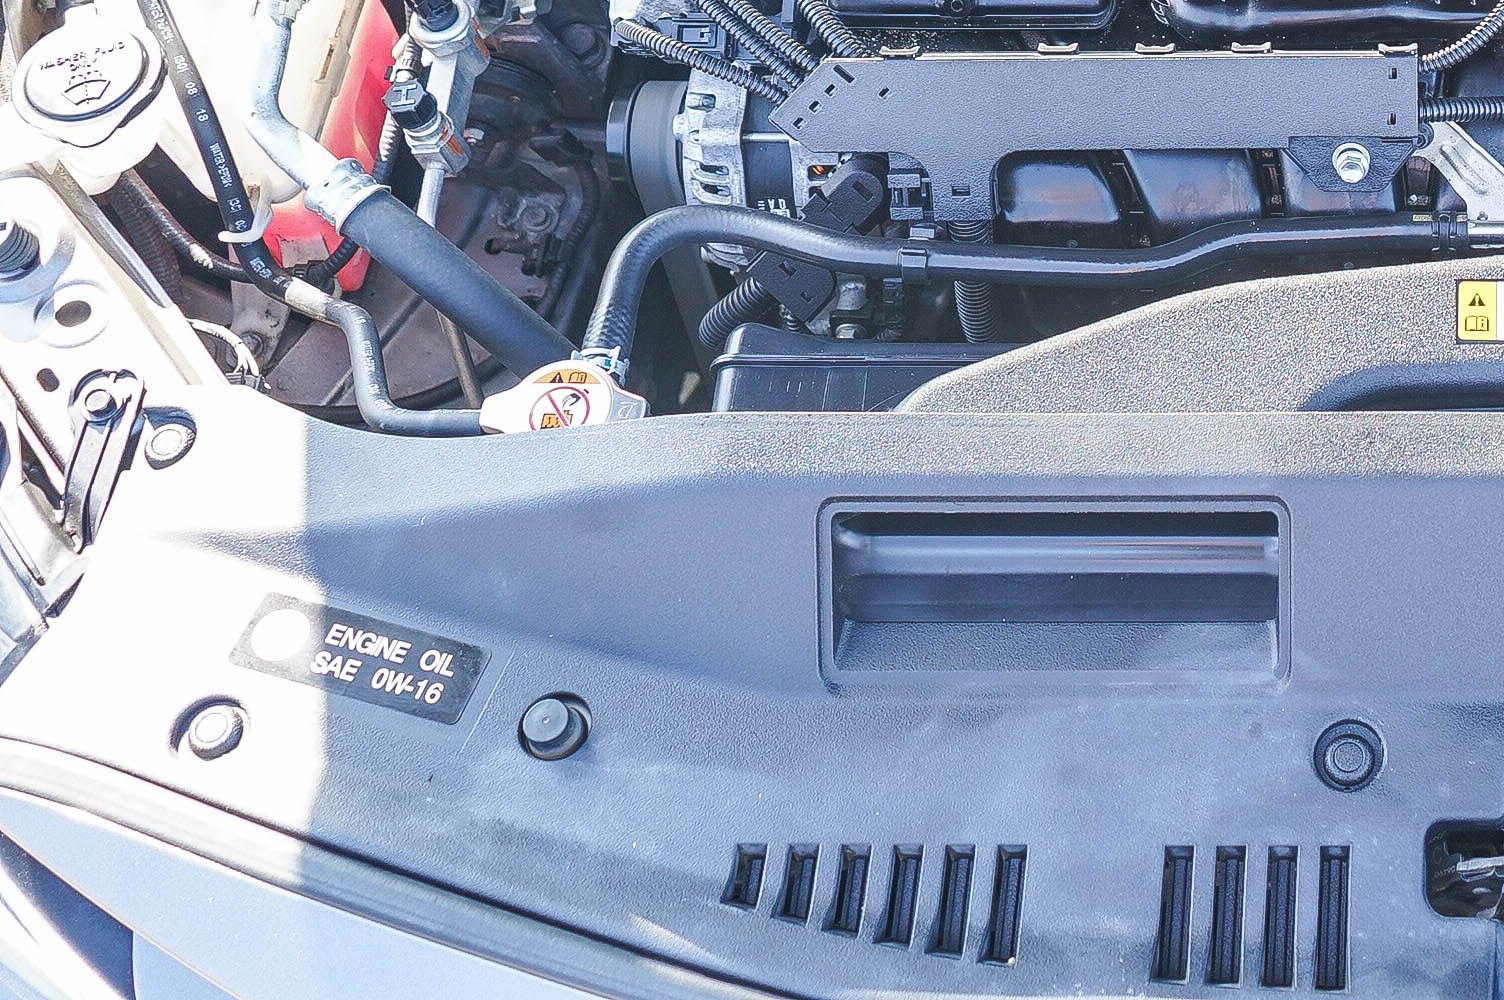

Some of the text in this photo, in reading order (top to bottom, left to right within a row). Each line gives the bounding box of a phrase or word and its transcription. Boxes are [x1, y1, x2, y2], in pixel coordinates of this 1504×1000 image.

[195, 107, 210, 123] 18
[310, 650, 445, 705] SAE 0W-16
[324, 622, 455, 678] ENGINE OIL
